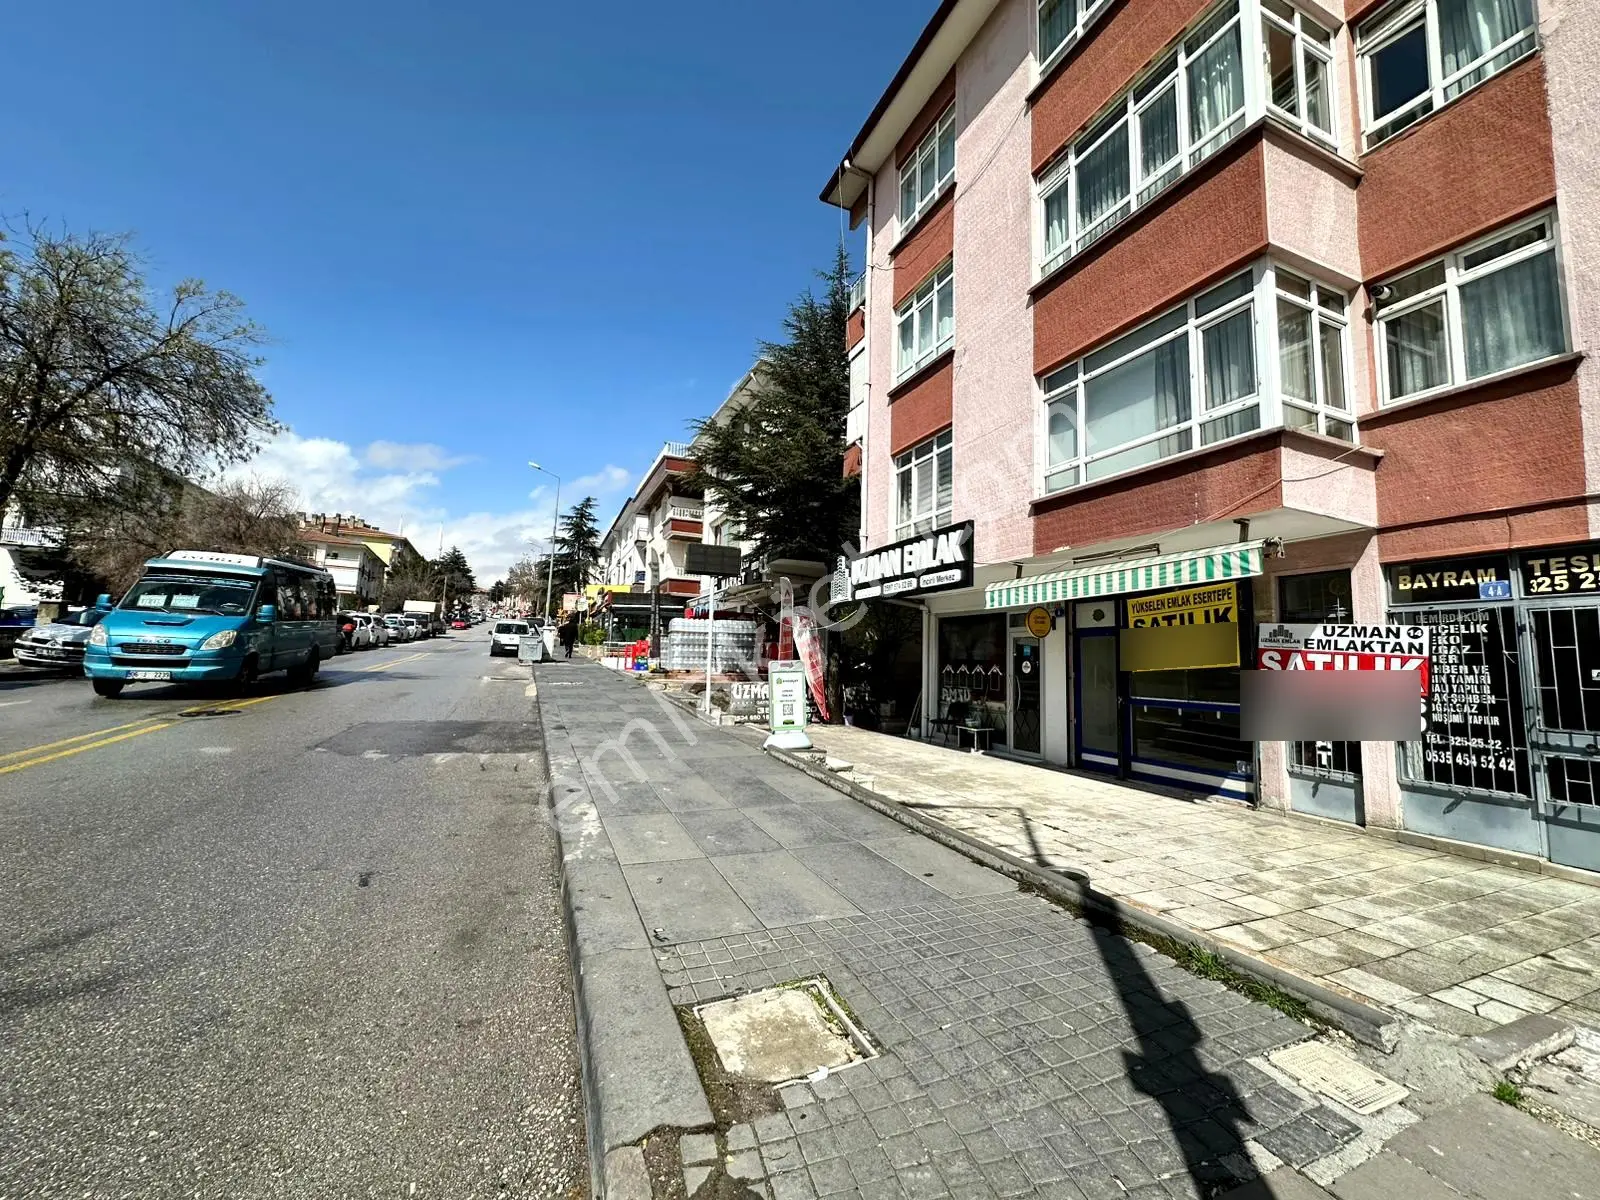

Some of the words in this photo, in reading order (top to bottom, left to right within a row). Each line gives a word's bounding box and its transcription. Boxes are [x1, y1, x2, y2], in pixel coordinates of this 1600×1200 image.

[903, 530, 965, 574] EMLAK
[1398, 568, 1496, 590] BAYRAM
[1530, 575, 1570, 593] 325
[1579, 572, 1600, 589] 2
[1131, 600, 1166, 614] YÜKSELEN
[1167, 595, 1191, 609] EMLAK
[1193, 587, 1232, 604] ESERTEPE
[1322, 625, 1400, 640] UZMAN
[1303, 638, 1423, 656] EMLAKTAN
